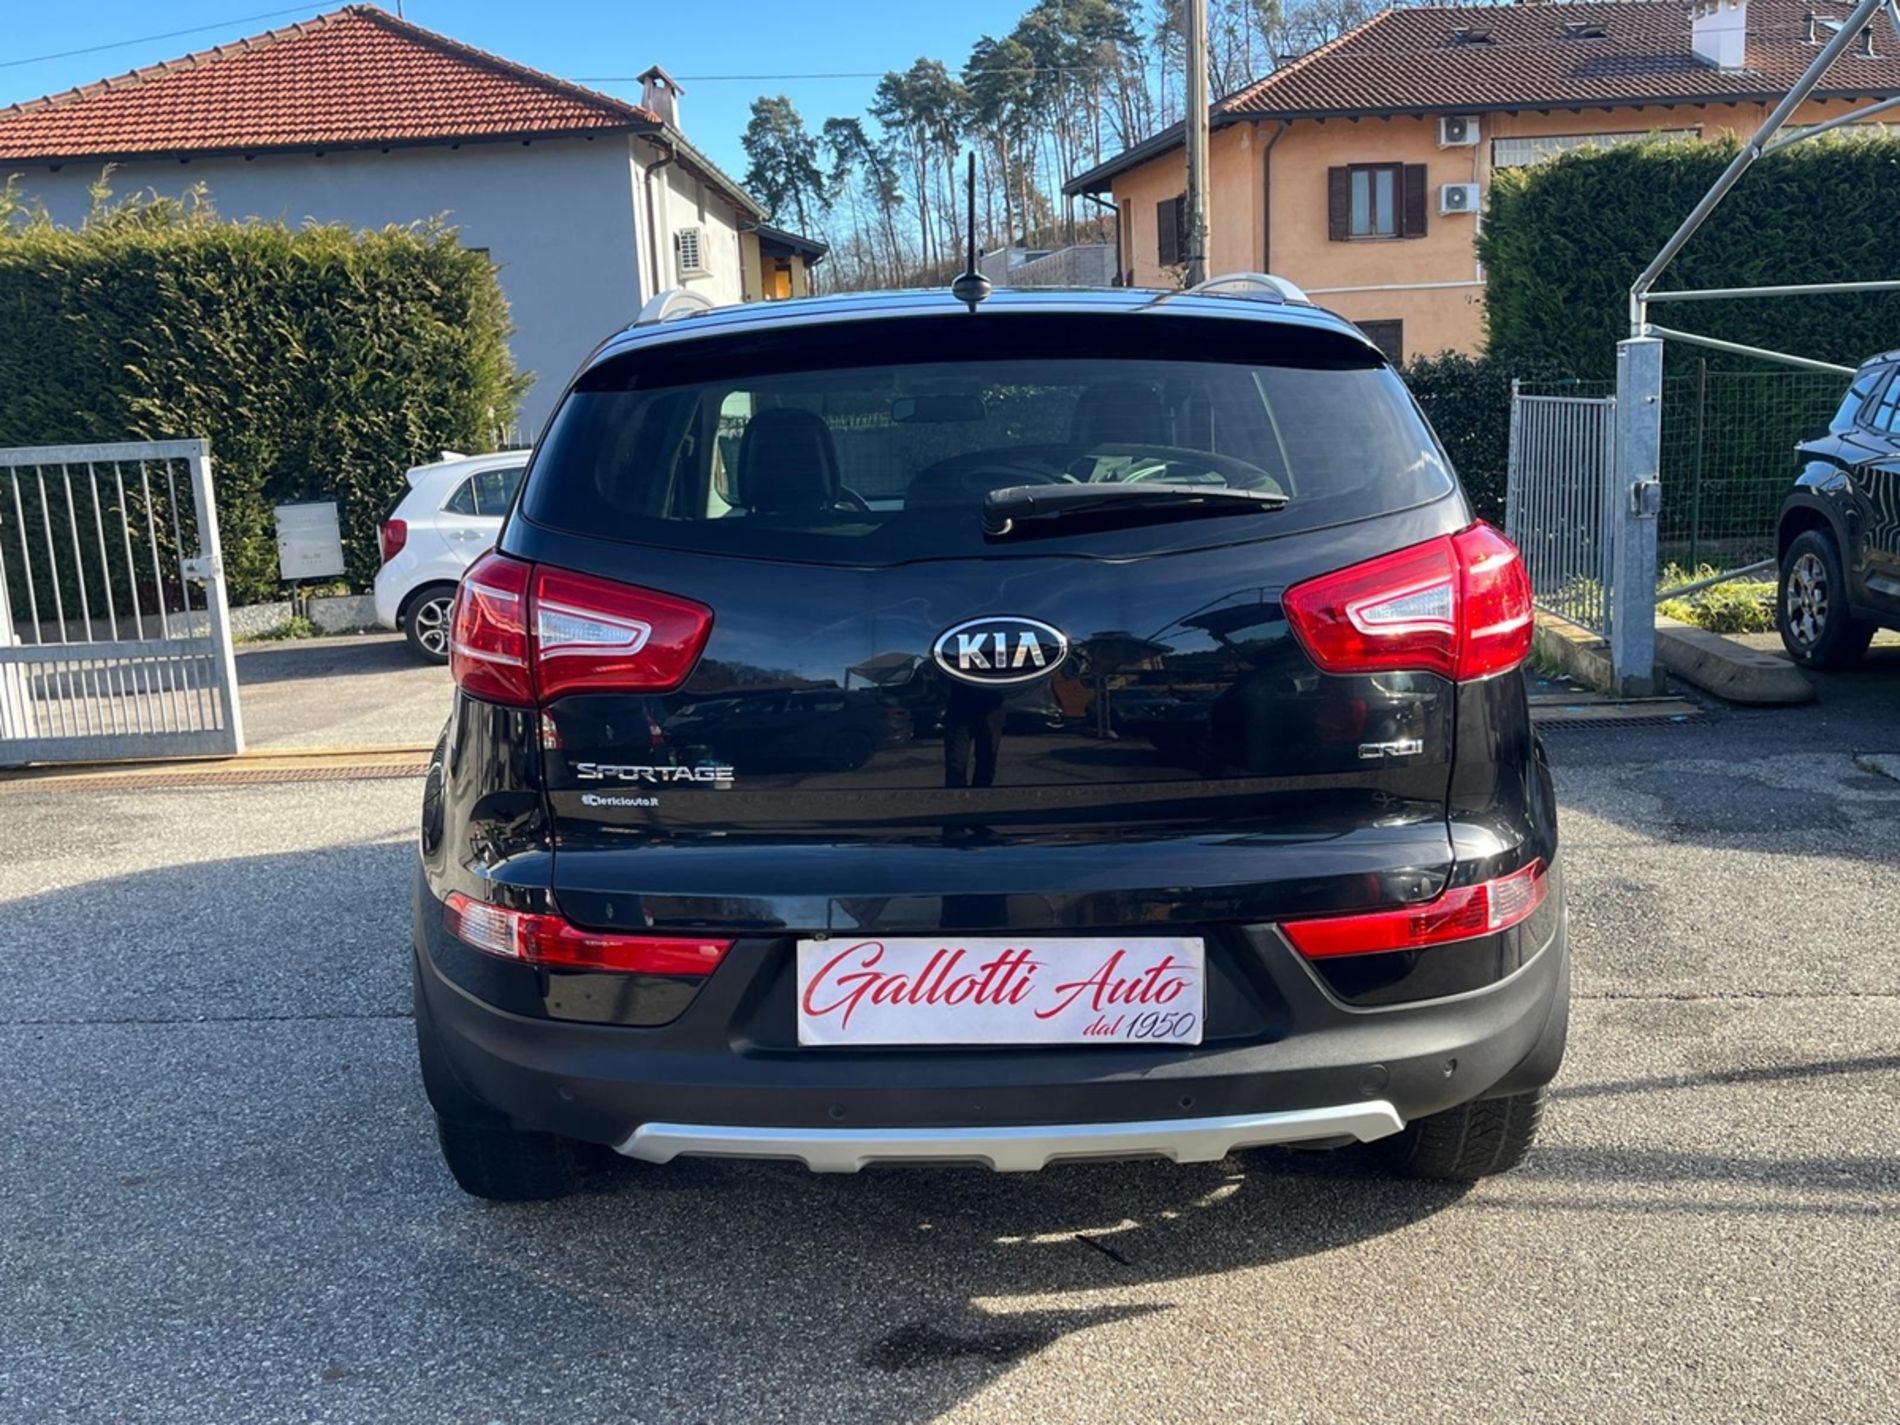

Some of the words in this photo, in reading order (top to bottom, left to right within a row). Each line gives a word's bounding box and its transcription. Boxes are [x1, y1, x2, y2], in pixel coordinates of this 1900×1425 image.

[956, 631, 1046, 669] KIA
[577, 763, 735, 783] SPORTAGE
[803, 941, 1047, 1031] Gallotti
[1034, 949, 1198, 1019] Auto
[1082, 1013, 1124, 1037] dal
[1125, 1011, 1197, 1039] 1950
